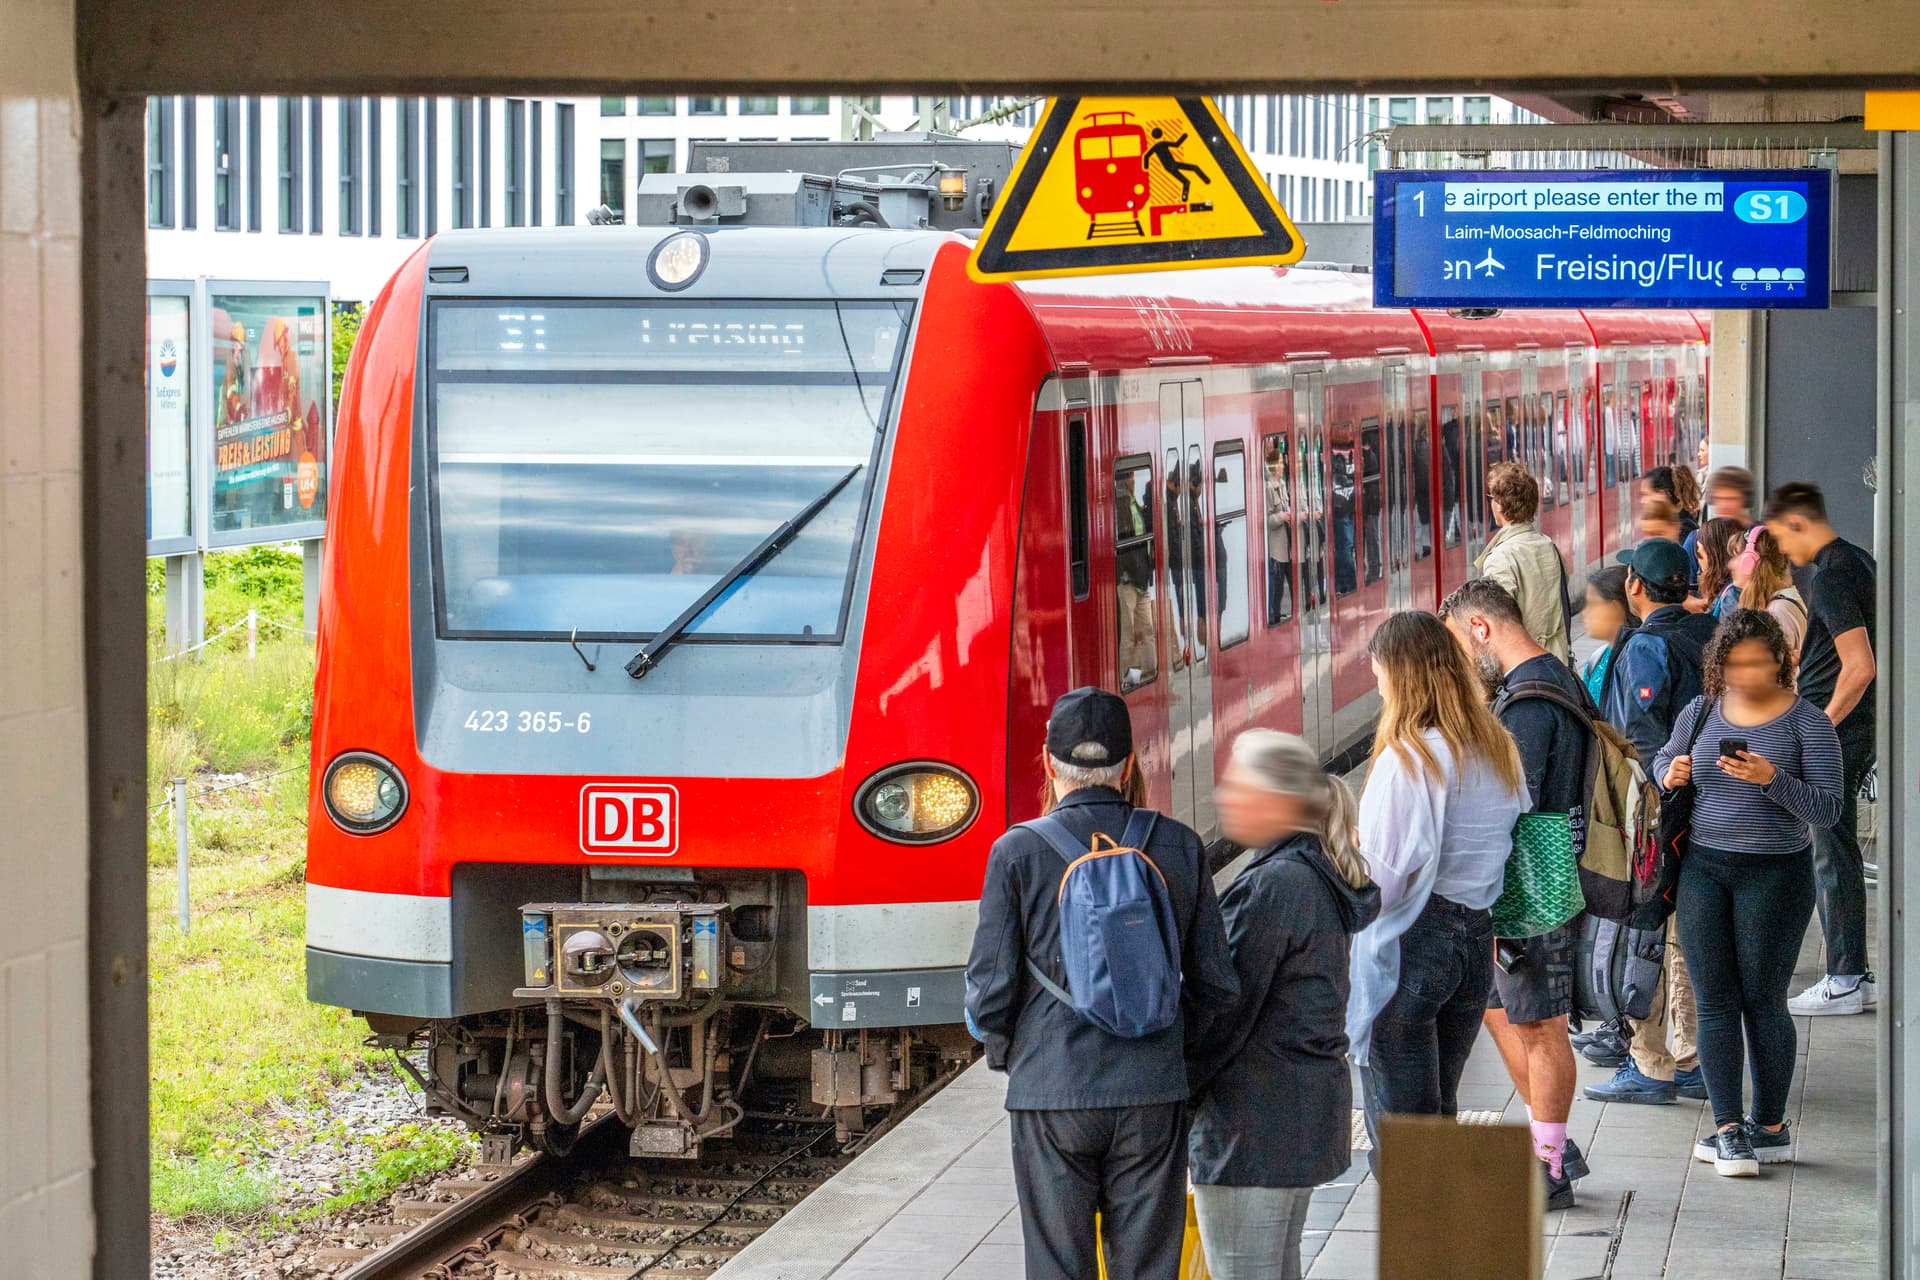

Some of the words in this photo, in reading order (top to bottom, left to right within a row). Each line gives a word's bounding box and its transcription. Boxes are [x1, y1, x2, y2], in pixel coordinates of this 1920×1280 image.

[1413, 190, 1425, 217] 1
[1463, 188, 1528, 210] airport
[1534, 188, 1600, 210] please
[1607, 188, 1660, 206] enter
[1666, 188, 1698, 206] the
[1749, 193, 1790, 221] S1
[1445, 224, 1671, 243] Laim-Moosach-Feldmoching
[1740, 283, 1748, 291] C
[1765, 283, 1772, 291] B
[1787, 283, 1795, 291] A
[251, 429, 291, 464] LEISTUNG
[464, 710, 508, 732] 423
[517, 711, 592, 733] 365-6
[594, 797, 665, 842] DB
